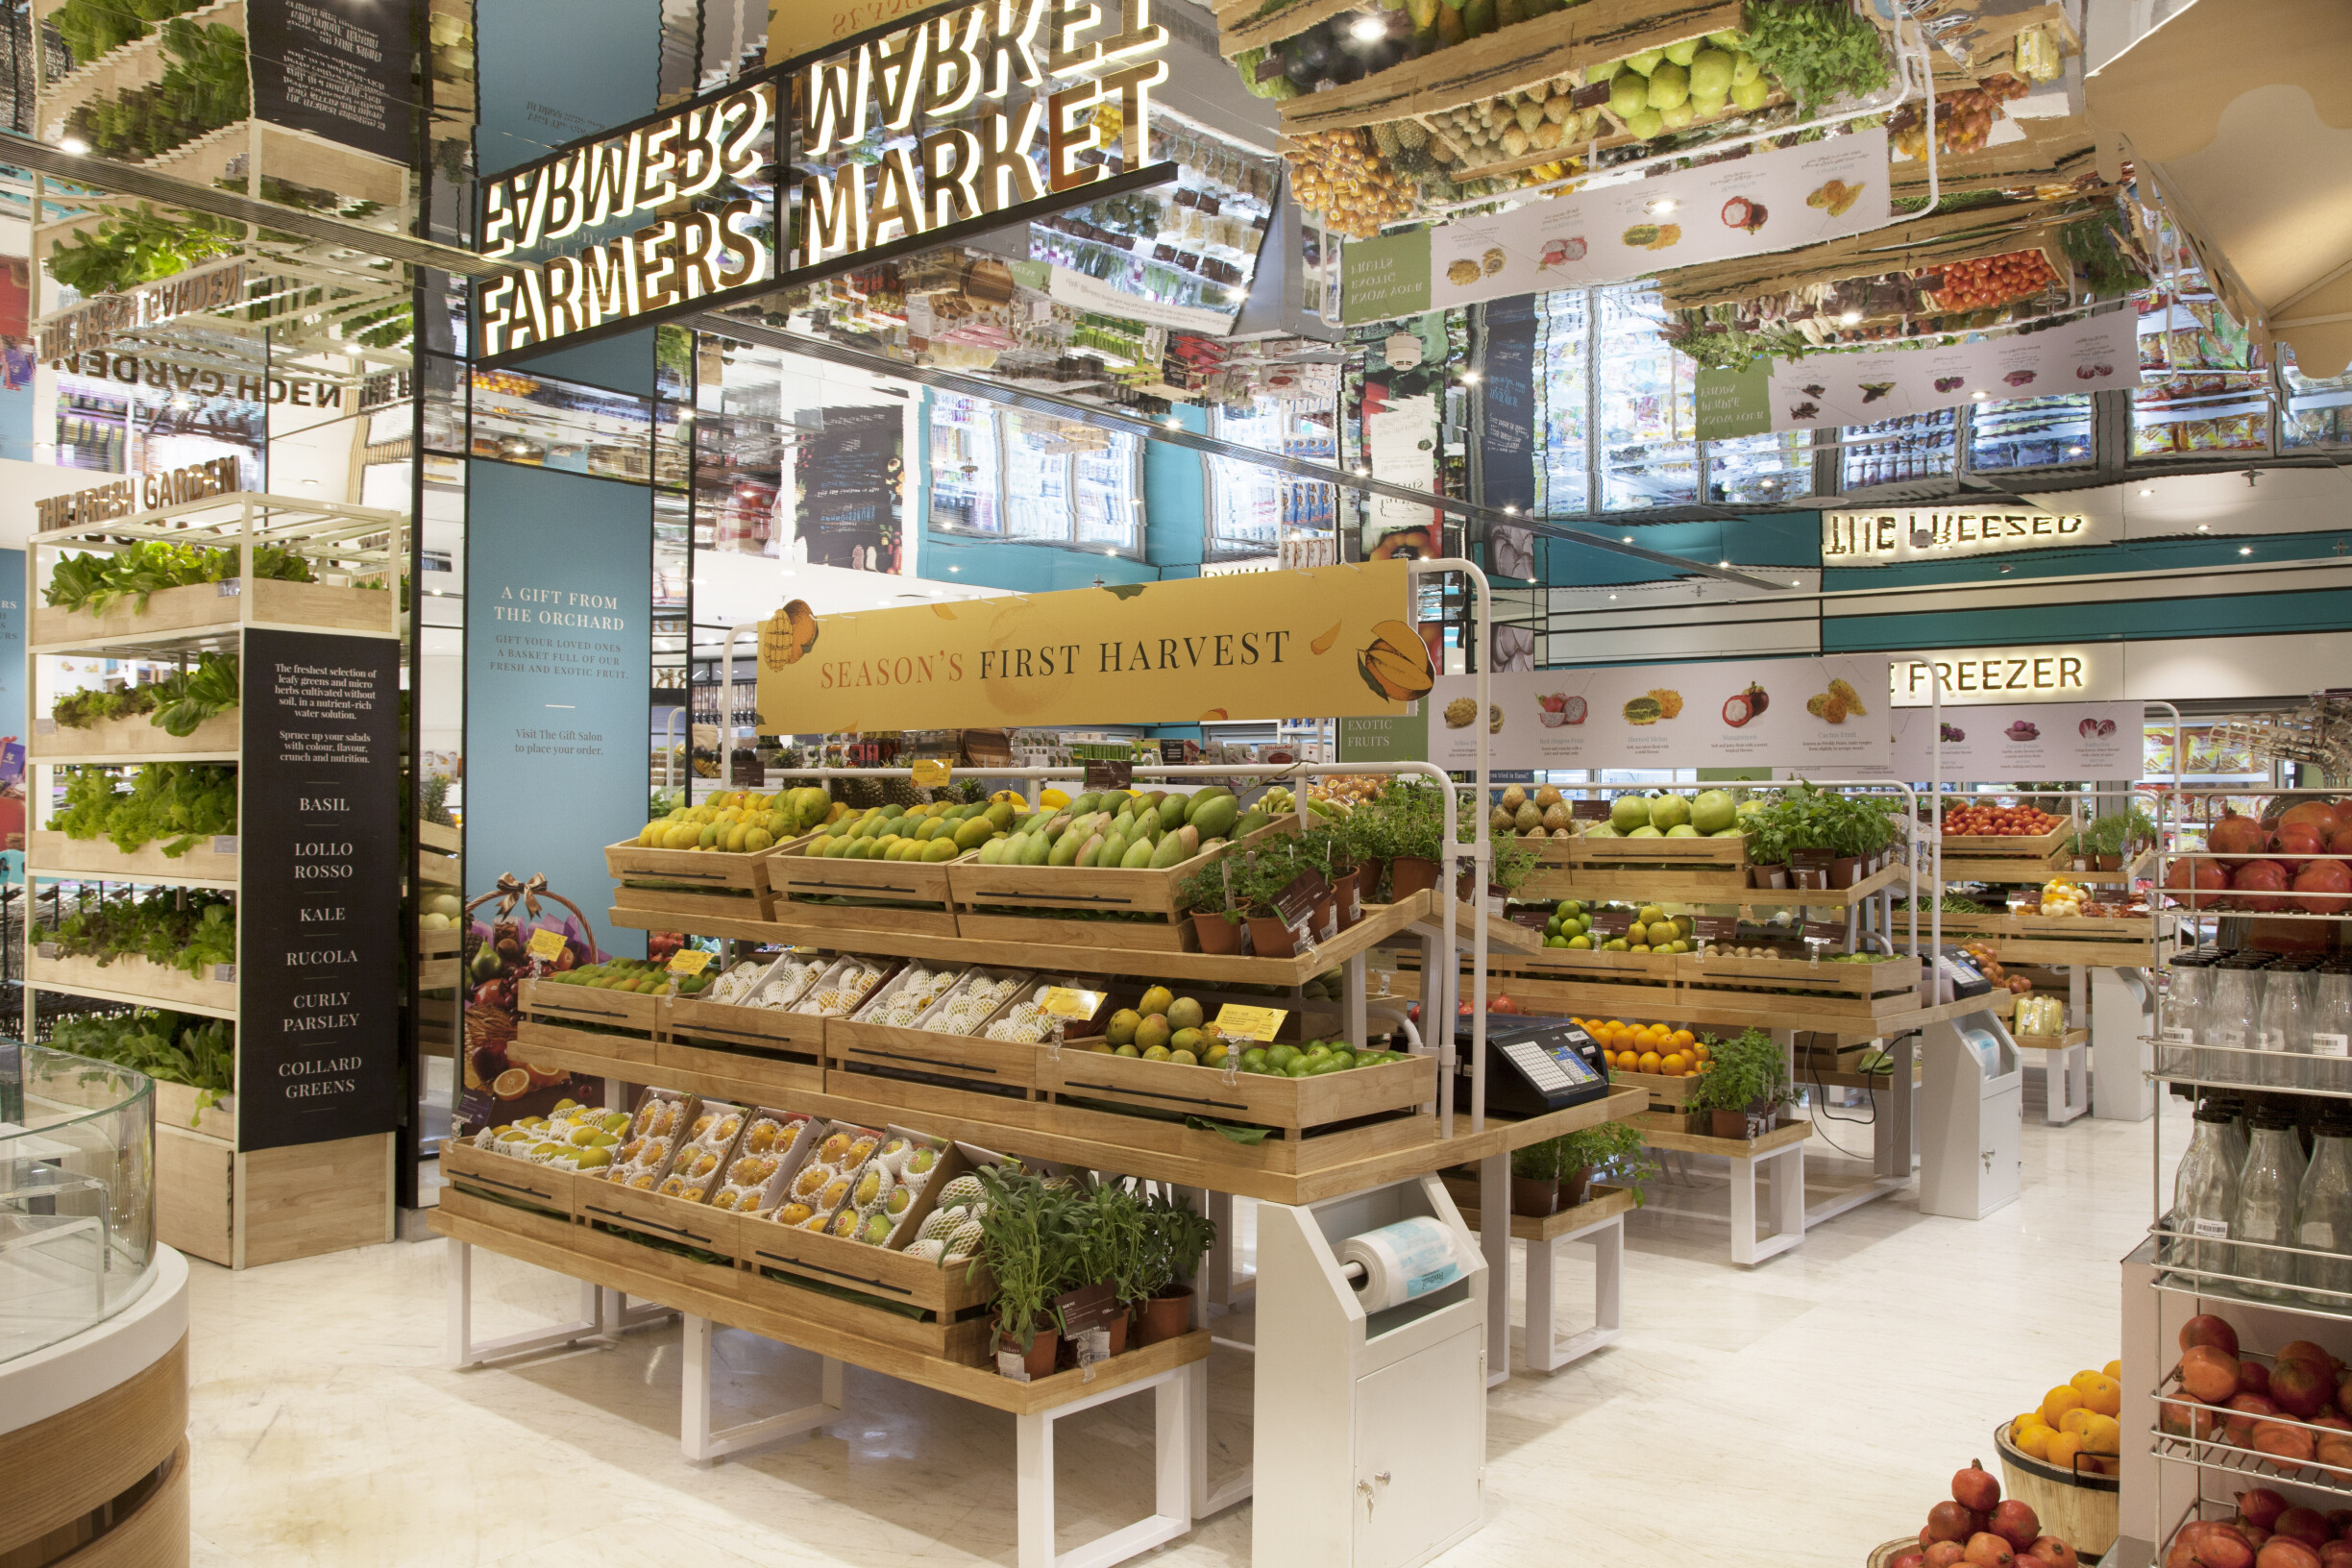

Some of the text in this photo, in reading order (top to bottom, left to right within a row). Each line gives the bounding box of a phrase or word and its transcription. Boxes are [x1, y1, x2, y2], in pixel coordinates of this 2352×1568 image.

[477, 60, 1169, 357] FARMERS MARKET
[36, 454, 240, 532] THE FRESH GARDEN
[501, 586, 618, 610] A GIFT FROM
[494, 606, 625, 631] THE ORCHARD
[496, 635, 622, 653] GIFT YOUR LOVED ONES
[497, 649, 620, 666] A BASKET FULL OF OUR
[980, 644, 1081, 680] FIRST
[1098, 630, 1291, 674] HARVEST
[275, 663, 377, 678] The freshest selection of
[490, 661, 629, 680] FRESH AND EXOTIC FRUIT.
[1909, 657, 2083, 693] FREEZER
[278, 674, 373, 688] leafy greens and micro
[275, 685, 376, 699] herbs cultivated without
[299, 698, 307, 706] in
[316, 699, 372, 710] nutrient-rich
[294, 709, 357, 720] water solution.
[1348, 720, 1392, 730] EXOTIC
[279, 730, 371, 742] Spruce up your salads
[516, 728, 602, 742] Visit The Gift Salon
[1348, 736, 1390, 747] FRUITS
[284, 741, 304, 750] with
[306, 742, 335, 752] colour,
[515, 743, 603, 756] to place your order.
[280, 752, 370, 764] crunch and nutrition.
[299, 797, 350, 811] BASIL
[294, 843, 354, 856] LOLLO
[294, 865, 354, 879] ROSSO
[300, 907, 346, 921] KALE
[286, 949, 358, 967] RUCOLA
[293, 992, 351, 1009] CURLY
[282, 1013, 360, 1032] PARSLEY
[278, 1056, 362, 1077] COLLARD
[285, 1079, 355, 1098] GREENS
